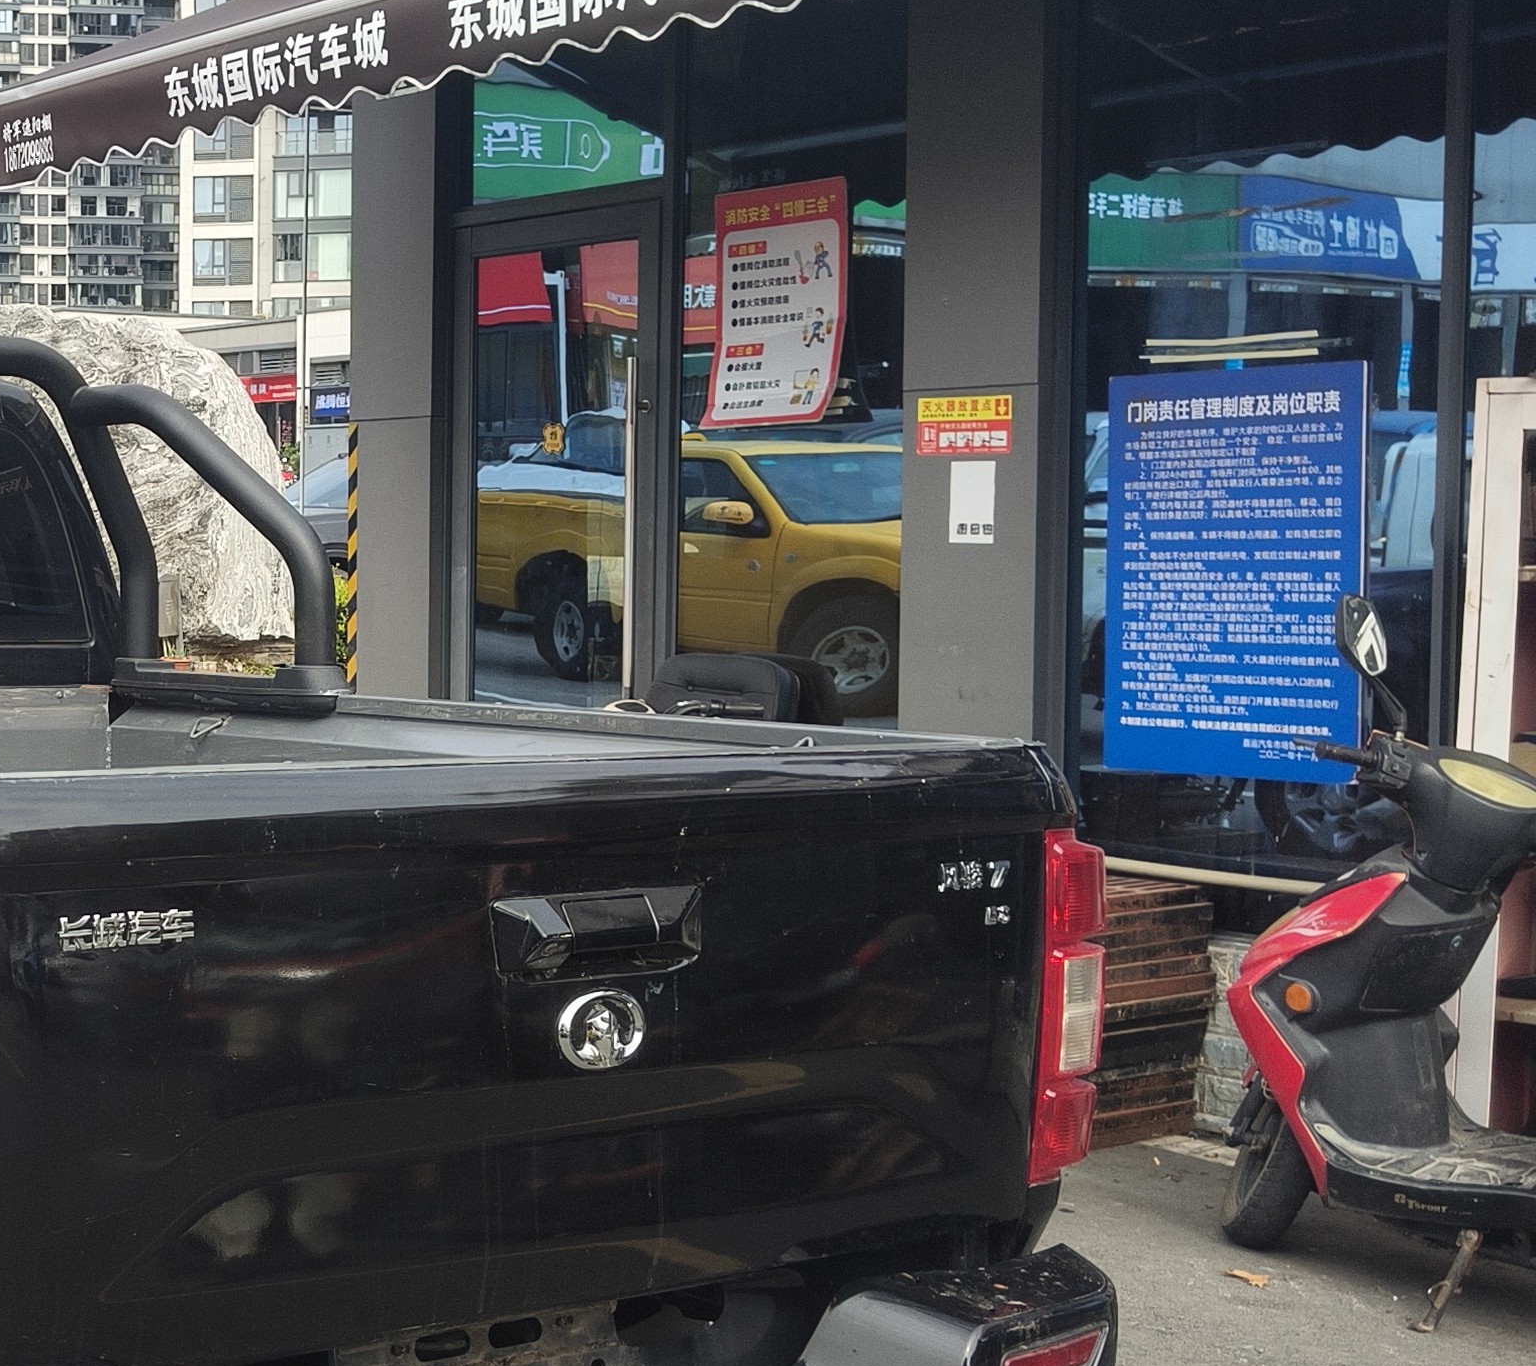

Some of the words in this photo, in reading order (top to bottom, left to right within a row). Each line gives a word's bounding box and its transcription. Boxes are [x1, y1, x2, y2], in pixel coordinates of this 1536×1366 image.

[164, 10, 389, 118] 东城国际汽车城
[922, 399, 992, 412] 灭火器放置点
[1127, 390, 1341, 423] 门岗责任管理制度及岗位职责
[58, 909, 195, 952] 长城汽车
